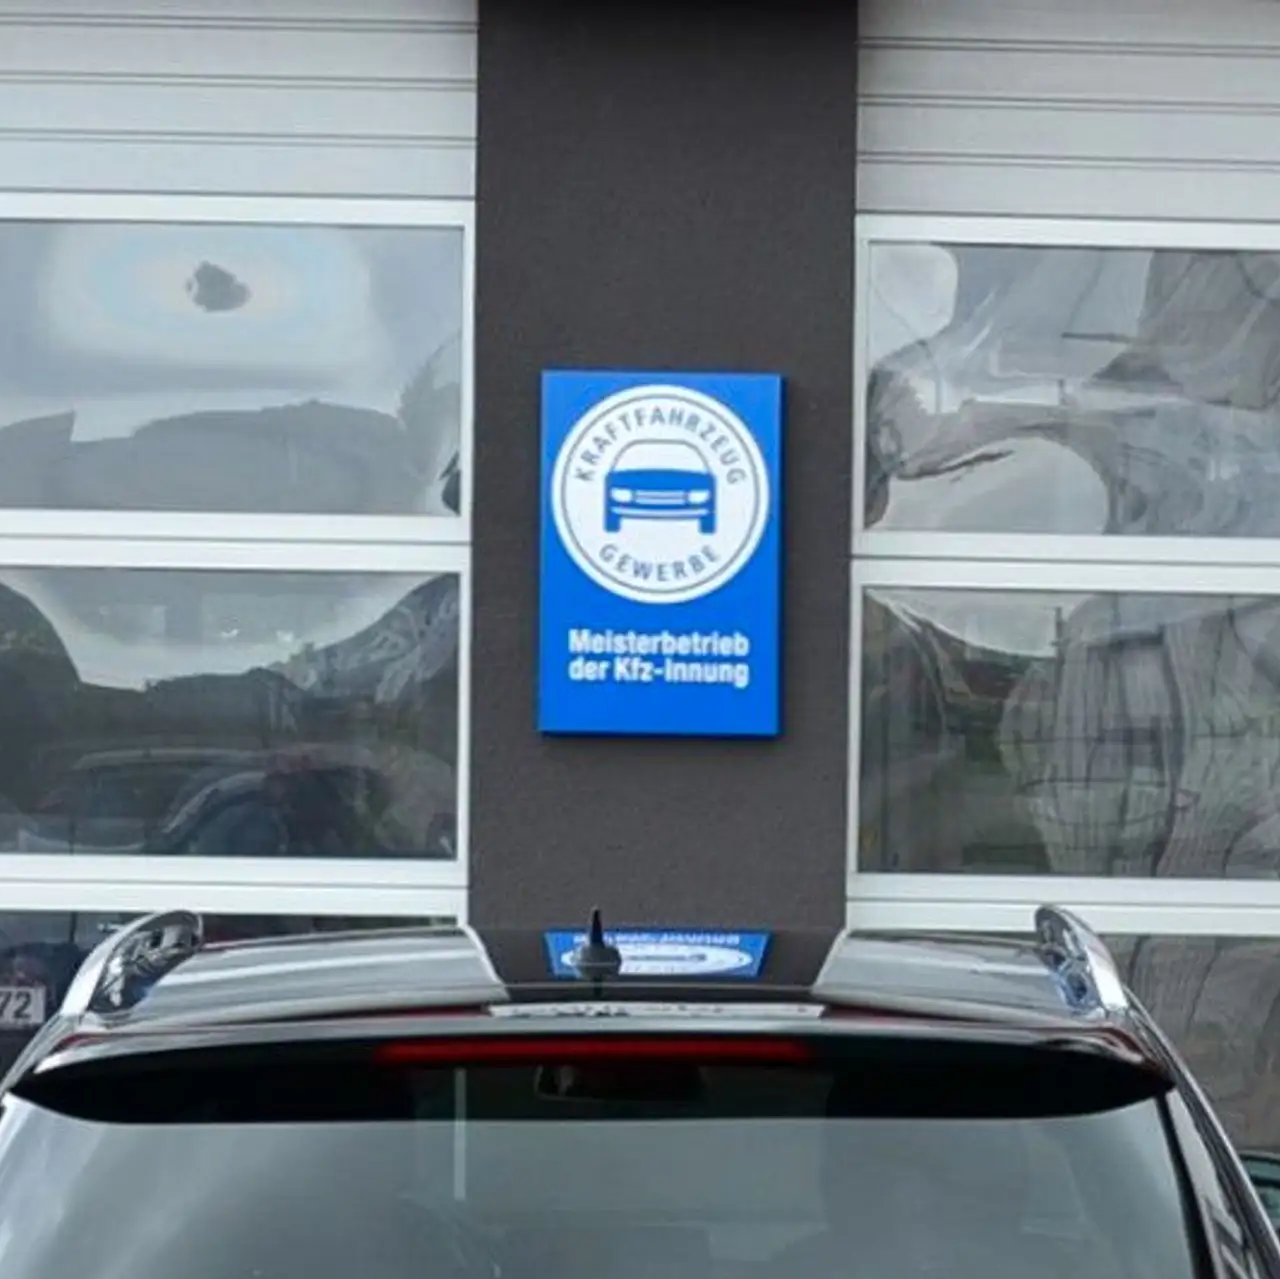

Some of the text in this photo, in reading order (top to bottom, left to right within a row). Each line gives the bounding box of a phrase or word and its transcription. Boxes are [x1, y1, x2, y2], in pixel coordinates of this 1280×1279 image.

[575, 407, 746, 485] KRAFTFAHRZEUG
[599, 543, 719, 582] GEWERBE
[568, 629, 749, 656] Meisterbetrieb
[568, 656, 749, 689] der Kfz-Innung
